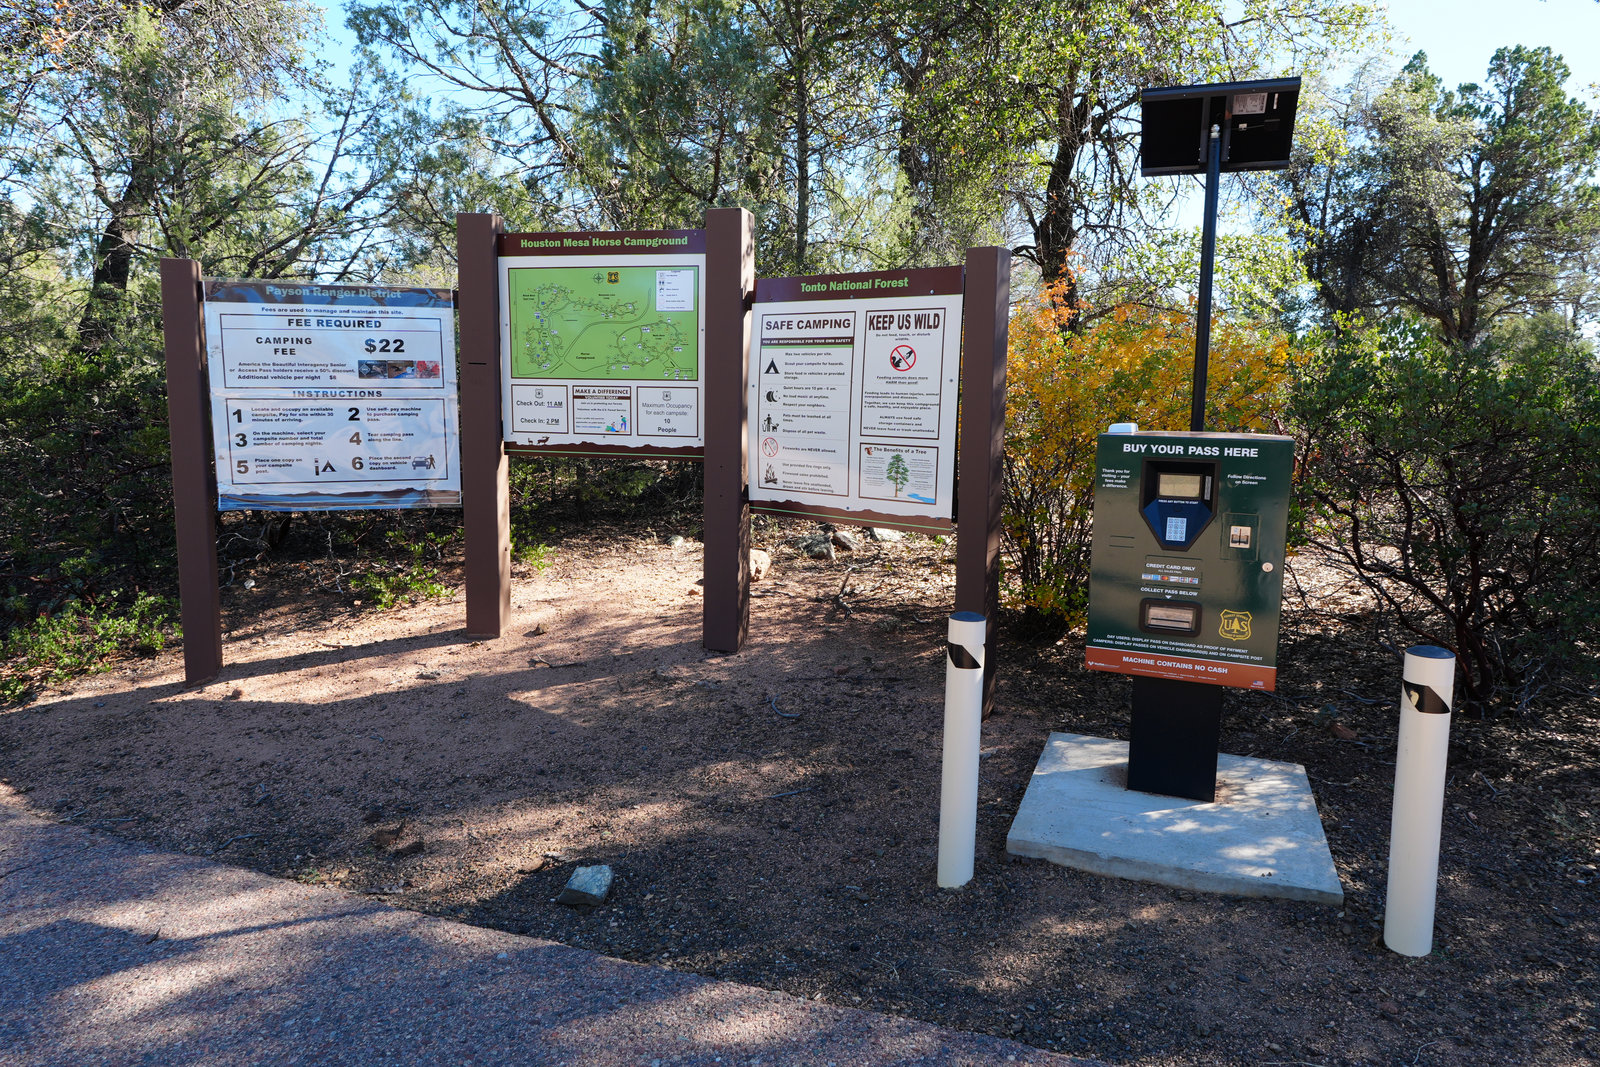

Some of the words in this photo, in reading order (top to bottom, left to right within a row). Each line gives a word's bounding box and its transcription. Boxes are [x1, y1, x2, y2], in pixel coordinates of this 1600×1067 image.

[521, 239, 560, 248] Houston
[592, 238, 621, 246] Horse
[624, 236, 688, 247] Campground
[801, 283, 827, 292] Tonto
[830, 279, 872, 290] National
[875, 277, 908, 288] Forest
[266, 286, 309, 296] Payson
[314, 287, 356, 298] Ranger
[359, 289, 401, 298] District
[317, 319, 381, 328] REQUIRED
[766, 321, 793, 330] SAFE
[797, 319, 851, 329] CAMPING
[869, 314, 894, 330] KEEP
[898, 314, 911, 330] US
[914, 313, 940, 329] WILD
[365, 338, 404, 354] $22
[233, 409, 242, 423] 1
[348, 407, 360, 421] 2
[235, 433, 247, 447] 3
[349, 432, 361, 445] 4
[1123, 443, 1147, 453] BUY
[1150, 445, 1184, 454] YOUR
[1188, 446, 1220, 456] PASS
[1224, 448, 1258, 457] HERE
[237, 460, 248, 474] 5
[352, 457, 363, 470] 6
[1123, 656, 1154, 665] MACHINE
[1157, 660, 1192, 669] CONTAINS
